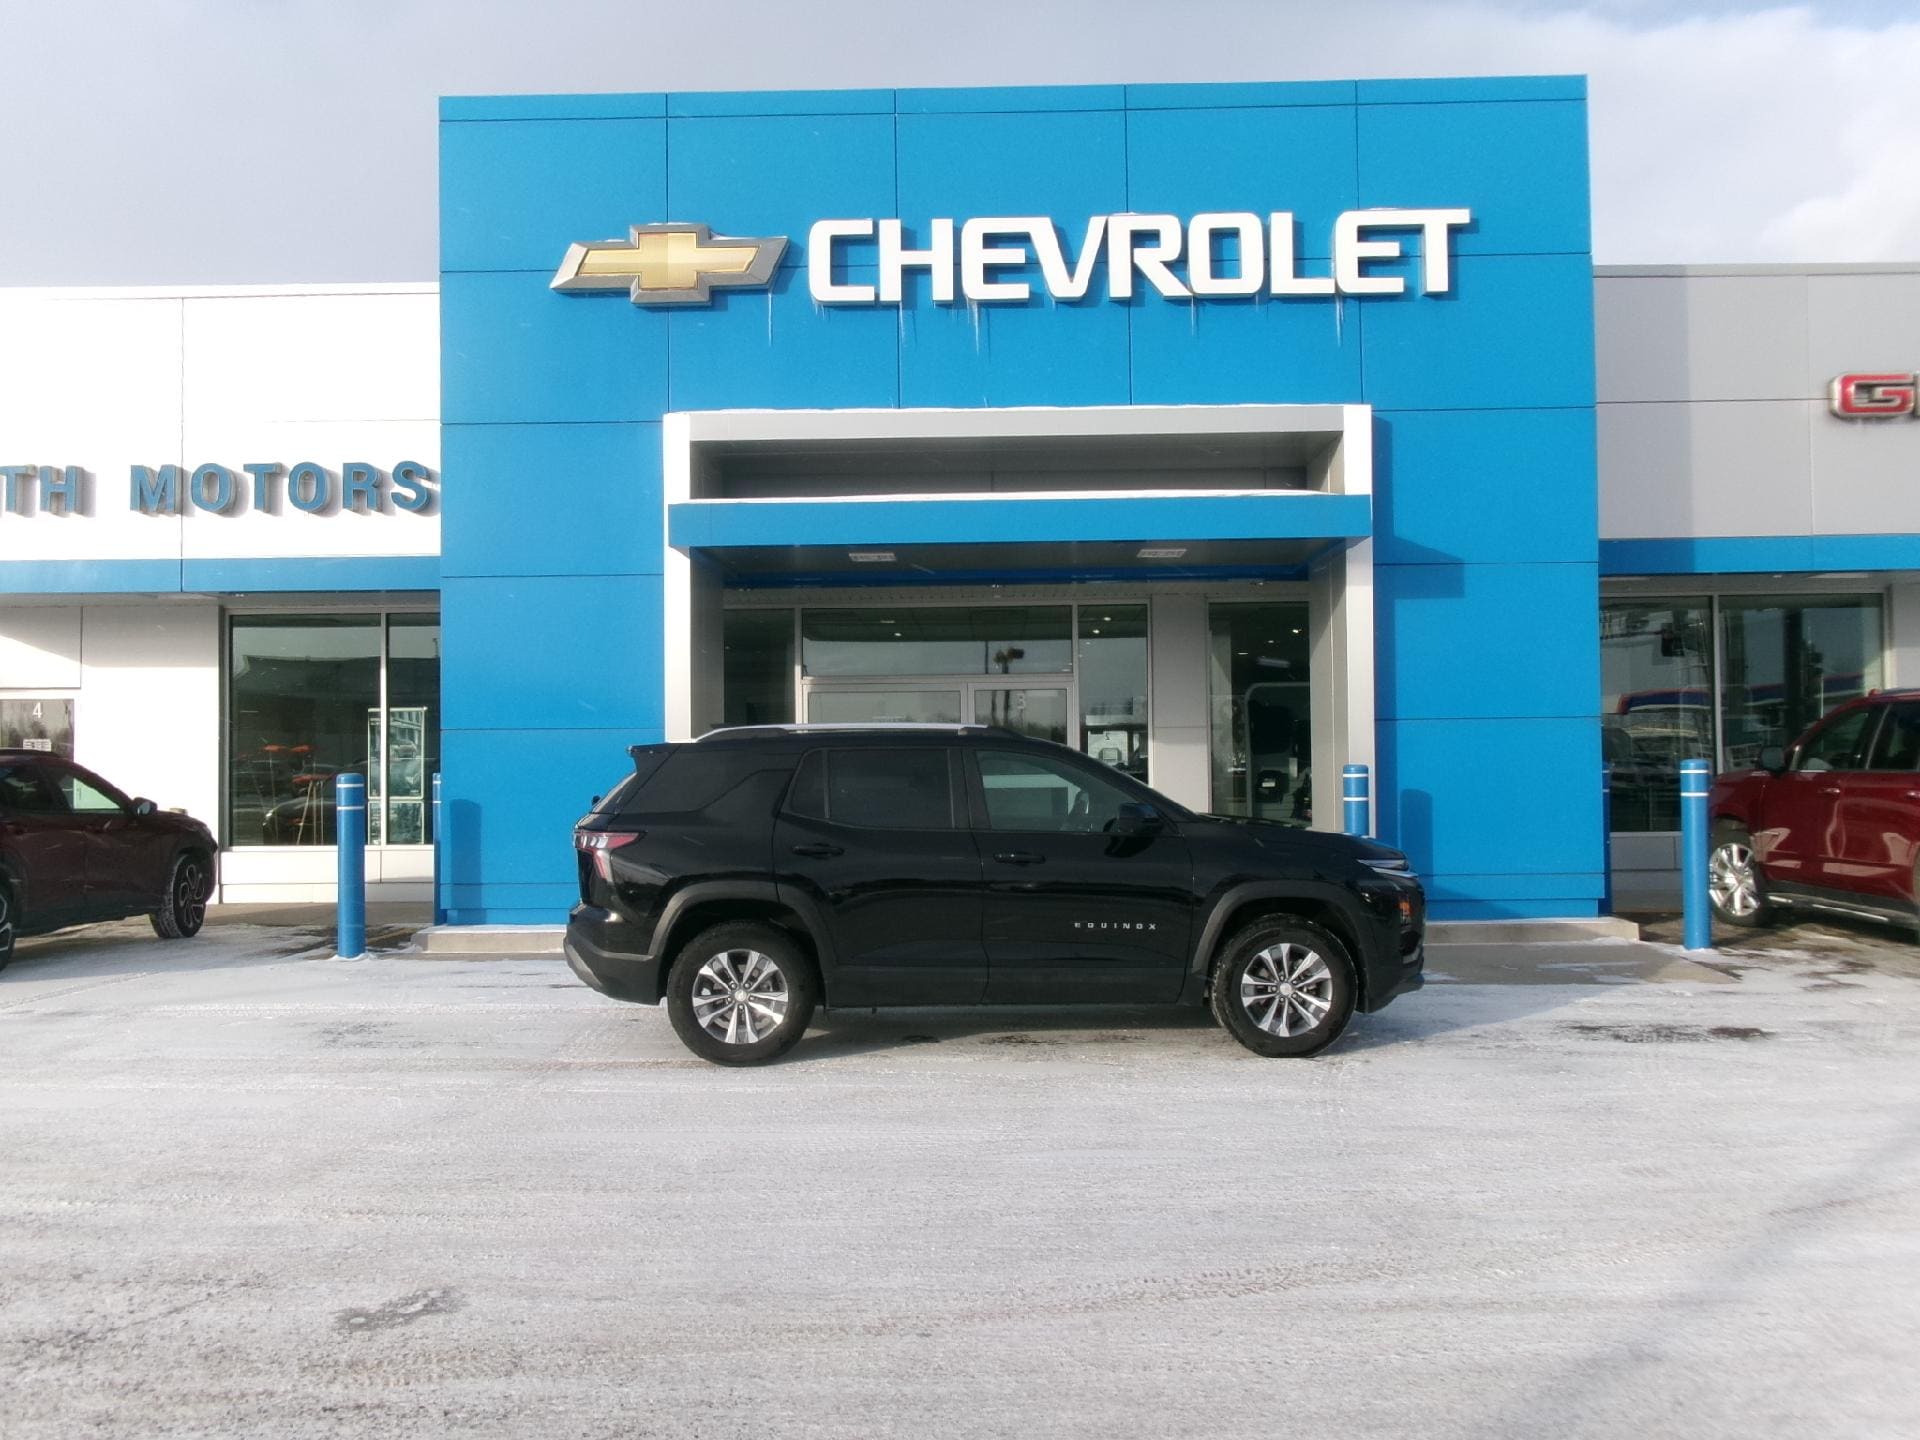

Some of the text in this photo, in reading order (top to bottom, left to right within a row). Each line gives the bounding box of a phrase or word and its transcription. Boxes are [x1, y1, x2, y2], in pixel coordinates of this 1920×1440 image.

[807, 207, 1472, 305] CHEVROLET
[1827, 371, 1920, 419] G
[130, 460, 438, 513] MOTORS
[32, 702, 43, 719] 4
[1074, 922, 1157, 931] EQUINOX
